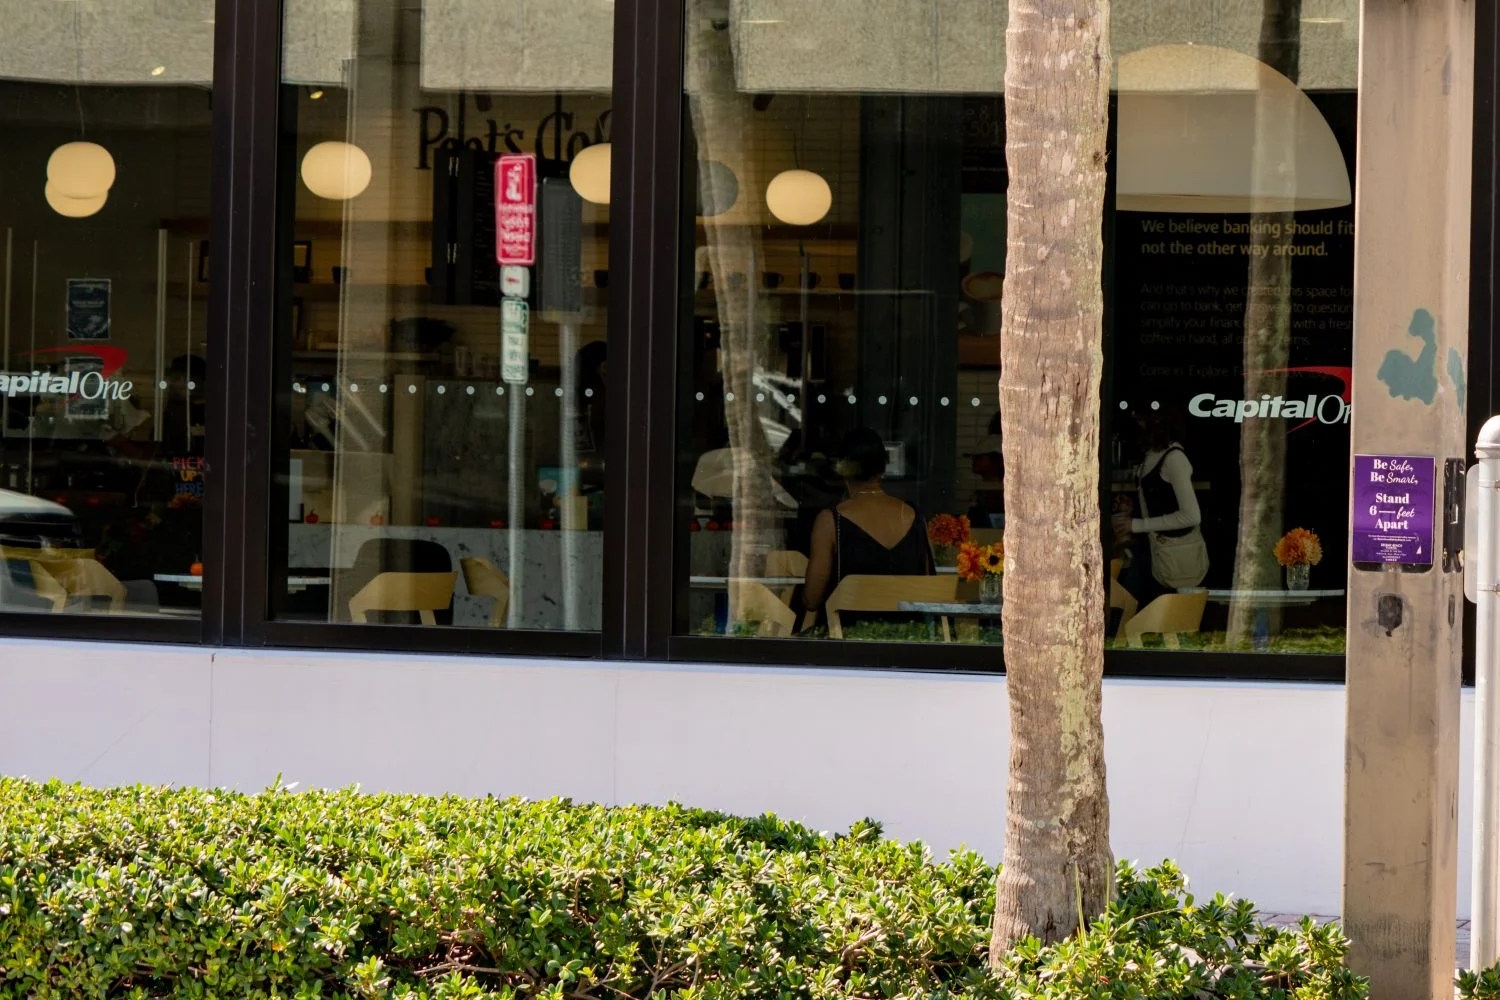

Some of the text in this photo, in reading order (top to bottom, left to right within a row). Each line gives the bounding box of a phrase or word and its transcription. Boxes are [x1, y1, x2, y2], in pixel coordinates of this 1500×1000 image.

[1141, 219, 1165, 233] We
[1169, 218, 1219, 234] believe
[1223, 219, 1281, 238] banking
[1285, 219, 1333, 235] should
[1141, 240, 1328, 260] not the other way around.
[1306, 286, 1337, 300] space
[1373, 458, 1388, 470] Be
[1370, 471, 1385, 482] Be
[1375, 492, 1410, 504] Stand
[1369, 505, 1415, 520] 6 feet
[1374, 518, 1409, 532] Apart
